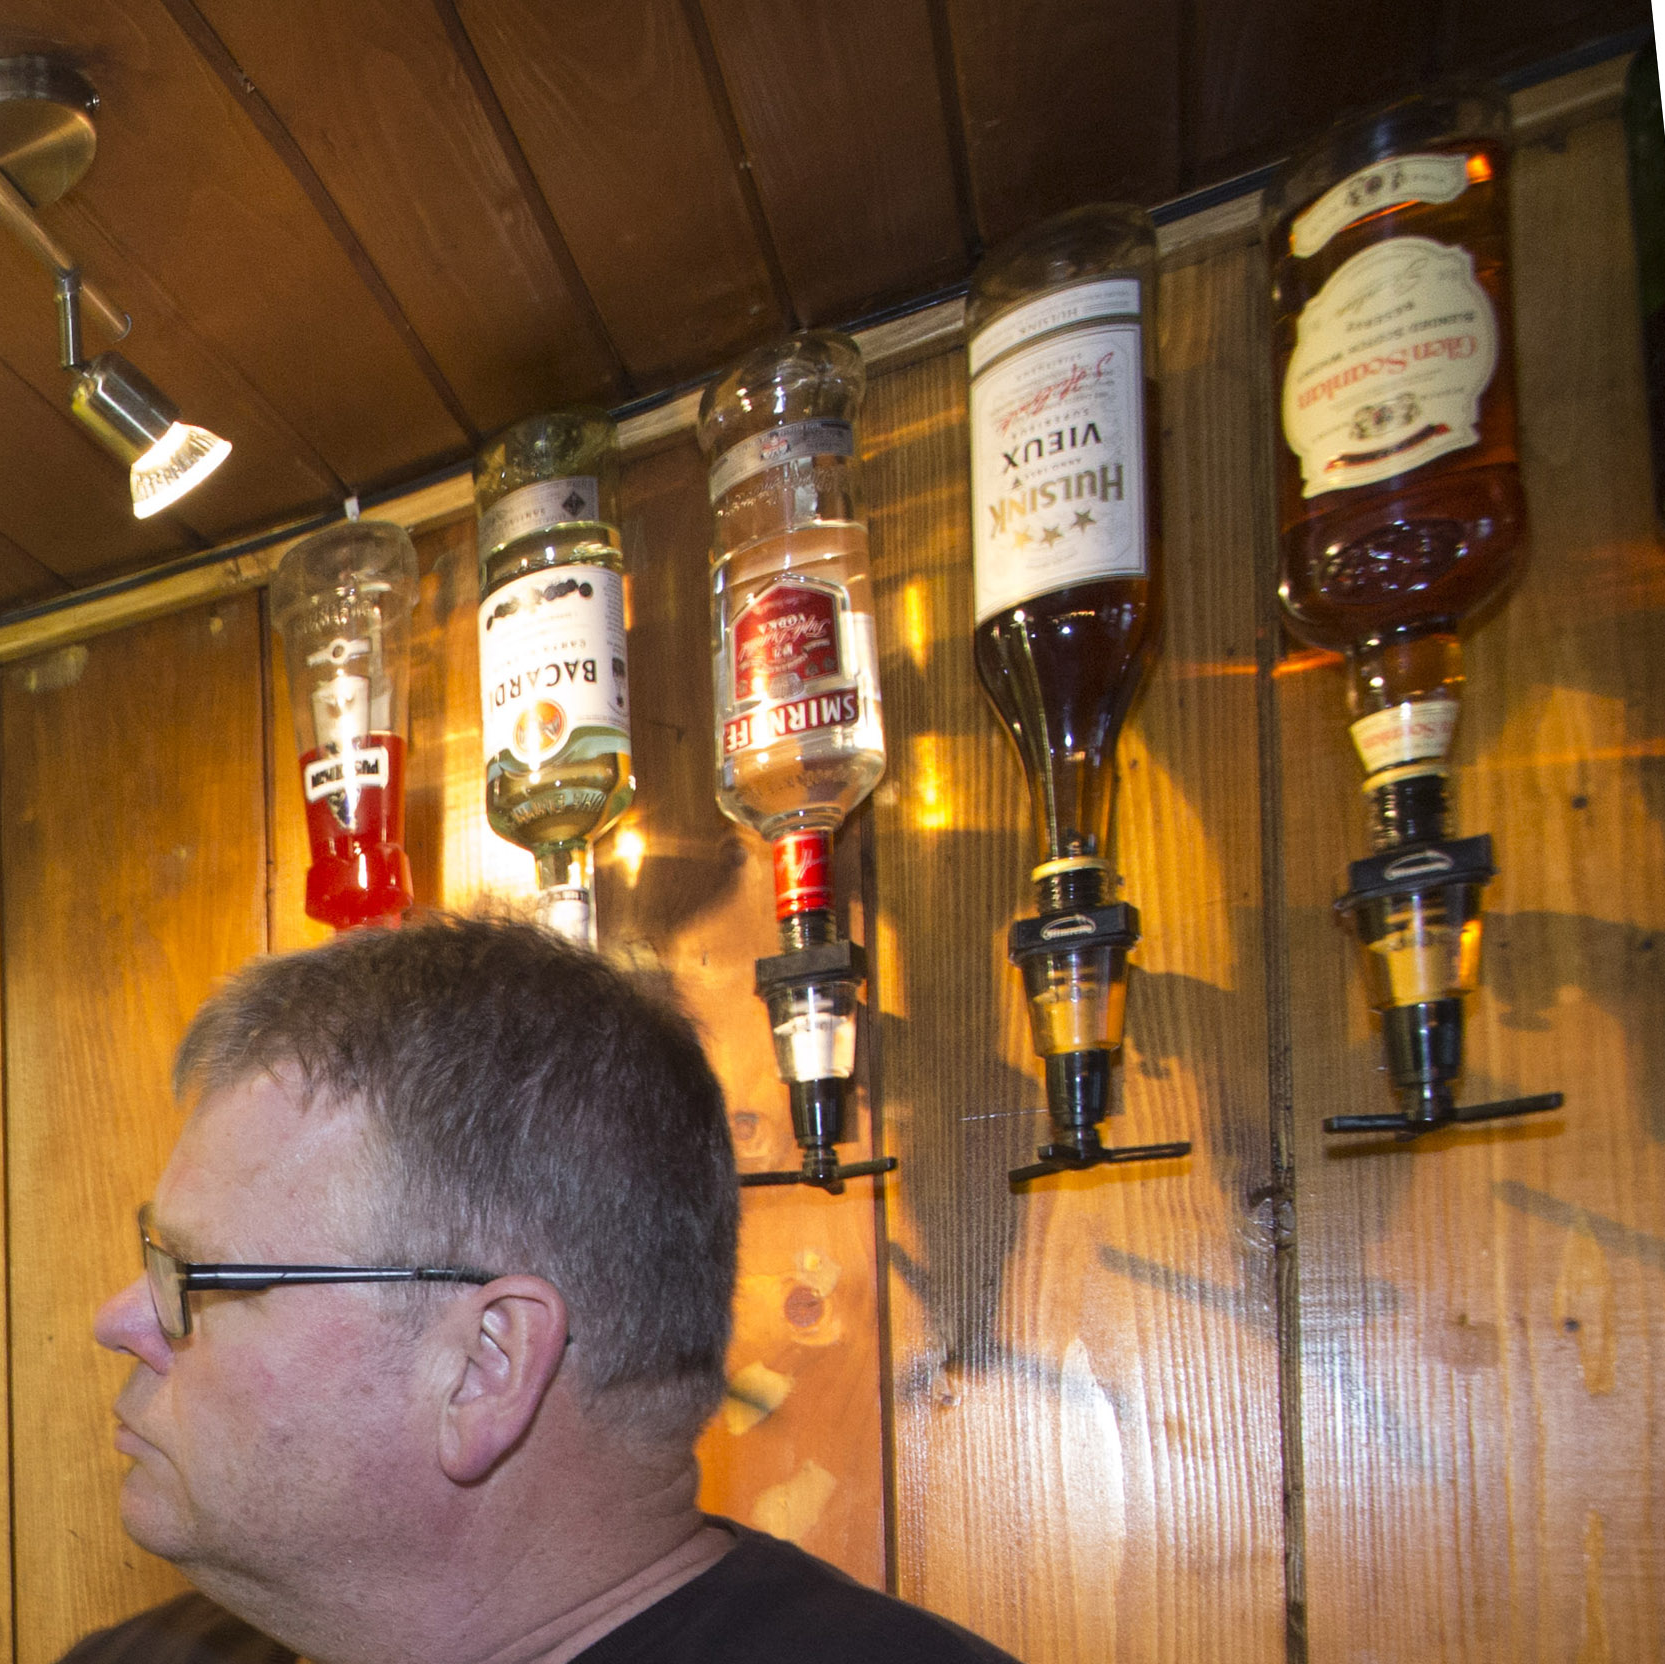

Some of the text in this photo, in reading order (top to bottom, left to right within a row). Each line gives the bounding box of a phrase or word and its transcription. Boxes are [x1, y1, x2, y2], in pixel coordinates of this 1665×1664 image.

[1411, 335, 1477, 360] Glen
[1002, 424, 1101, 475] VIEUX
[725, 693, 856, 753] SMIRNFF
